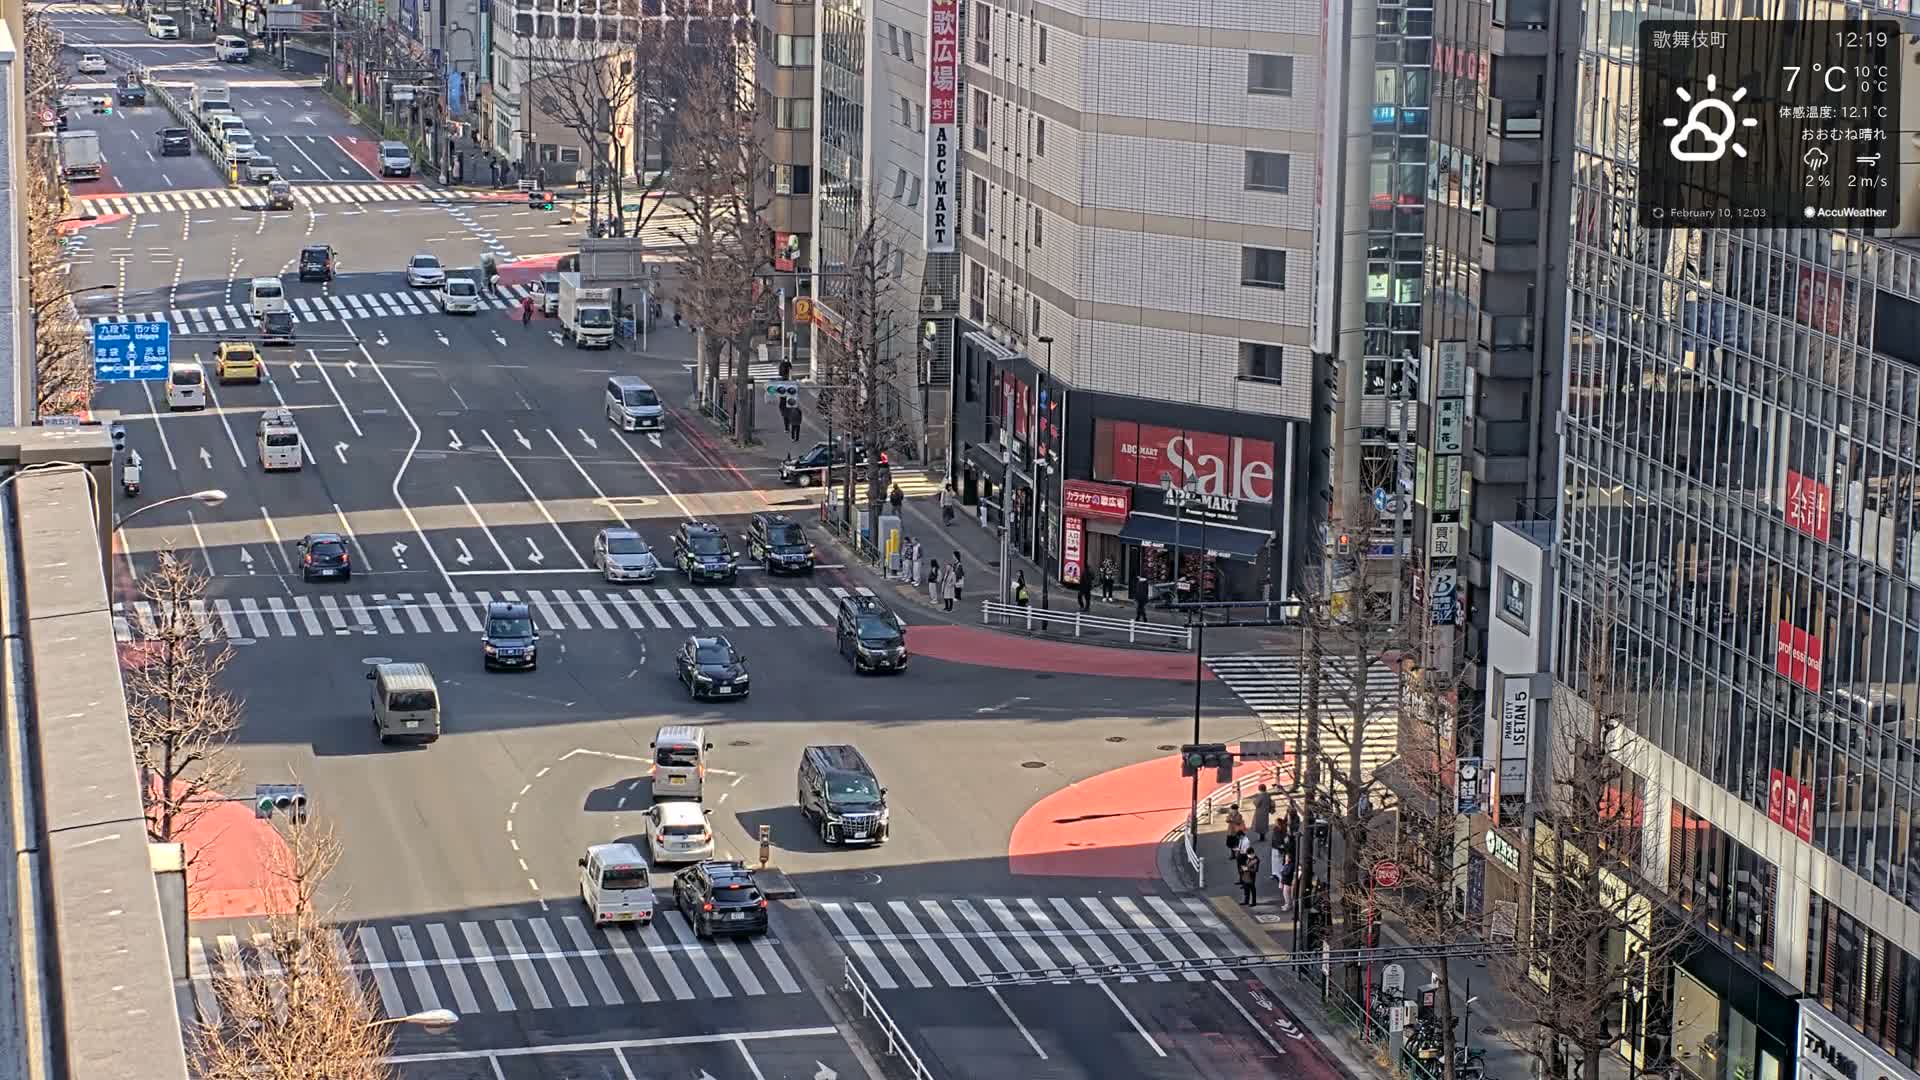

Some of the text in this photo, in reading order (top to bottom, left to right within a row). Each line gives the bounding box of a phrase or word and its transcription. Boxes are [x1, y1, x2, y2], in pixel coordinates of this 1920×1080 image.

[935, 128, 947, 243] ABC-MART
[1121, 443, 1158, 456] ABCMART
[1167, 436, 1273, 502] Sale
[1440, 514, 1451, 522] 7F
[1791, 481, 1826, 530] 会計
[1435, 526, 1448, 553] 買取
[1505, 701, 1513, 719] CITY
[1513, 691, 1527, 746] ISETAN 5
